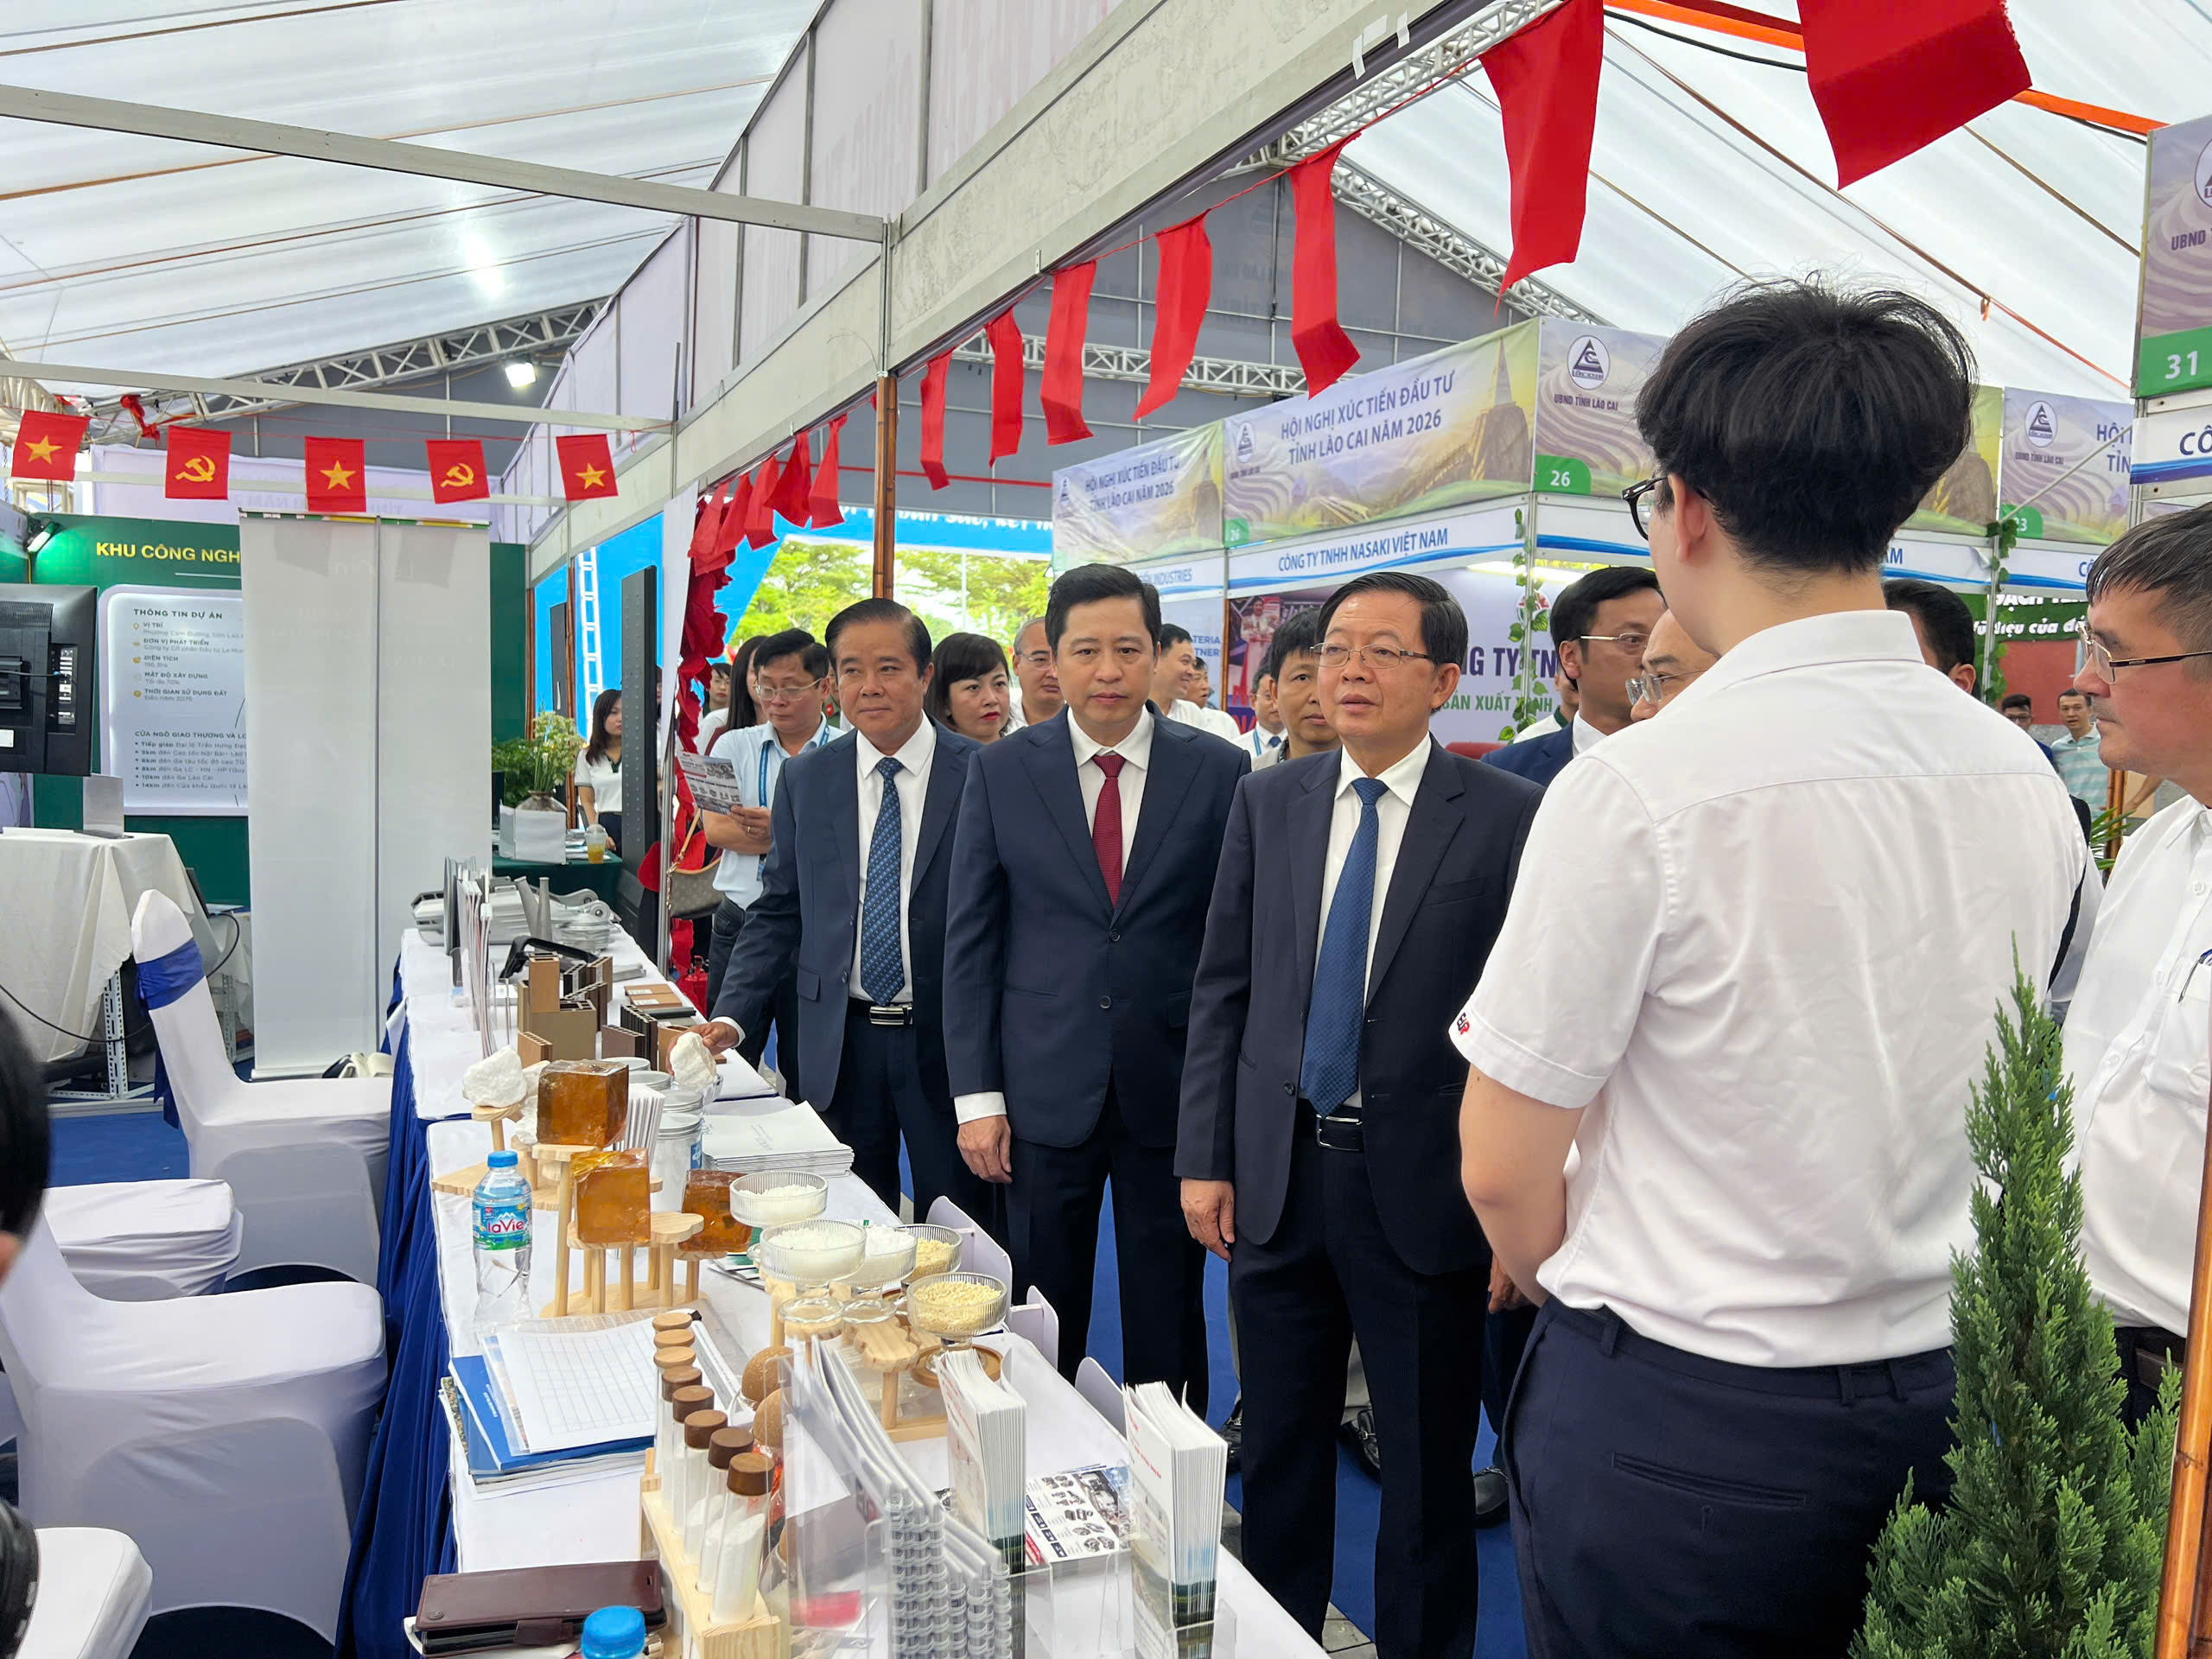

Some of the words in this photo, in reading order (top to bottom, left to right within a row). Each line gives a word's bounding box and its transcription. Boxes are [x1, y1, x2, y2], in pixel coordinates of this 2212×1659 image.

[2171, 230, 2206, 251] UBND
[2164, 350, 2198, 379] 31
[1281, 418, 1302, 442] HỘI
[1305, 410, 1335, 436] NGHỊ
[1338, 399, 1363, 424] XÚC
[1366, 386, 1396, 416] TIẾN
[1400, 378, 1430, 407] ĐẦU
[1433, 370, 1456, 395] TƯ
[1554, 393, 1573, 405] UBND
[1607, 400, 1618, 411] CAI
[1288, 442, 1317, 465] TỈNH
[1319, 433, 1344, 458] LÀO
[1346, 429, 1369, 450] CAI
[1371, 418, 1403, 445] NĂM
[1407, 409, 1442, 435] 2026
[2179, 424, 2212, 456] CÔ
[1550, 469, 1571, 487] 26
[96, 542, 137, 558] KHU
[141, 543, 197, 561] CÔNG
[201, 549, 241, 563] NGH
[1279, 552, 1306, 572] CÔNG
[1306, 550, 1319, 568] TY
[1319, 545, 1349, 566] TNHH
[1350, 537, 1391, 562] NASAKI
[1392, 531, 1418, 557] VIỆT
[1419, 527, 1449, 549] NAM
[133, 608, 168, 617] THÔNG
[191, 611, 206, 620] DỰ
[209, 610, 223, 620] ÁN
[2029, 617, 2059, 635] của
[1475, 690, 1511, 711] XUẤT
[487, 1217, 525, 1234] laVie
